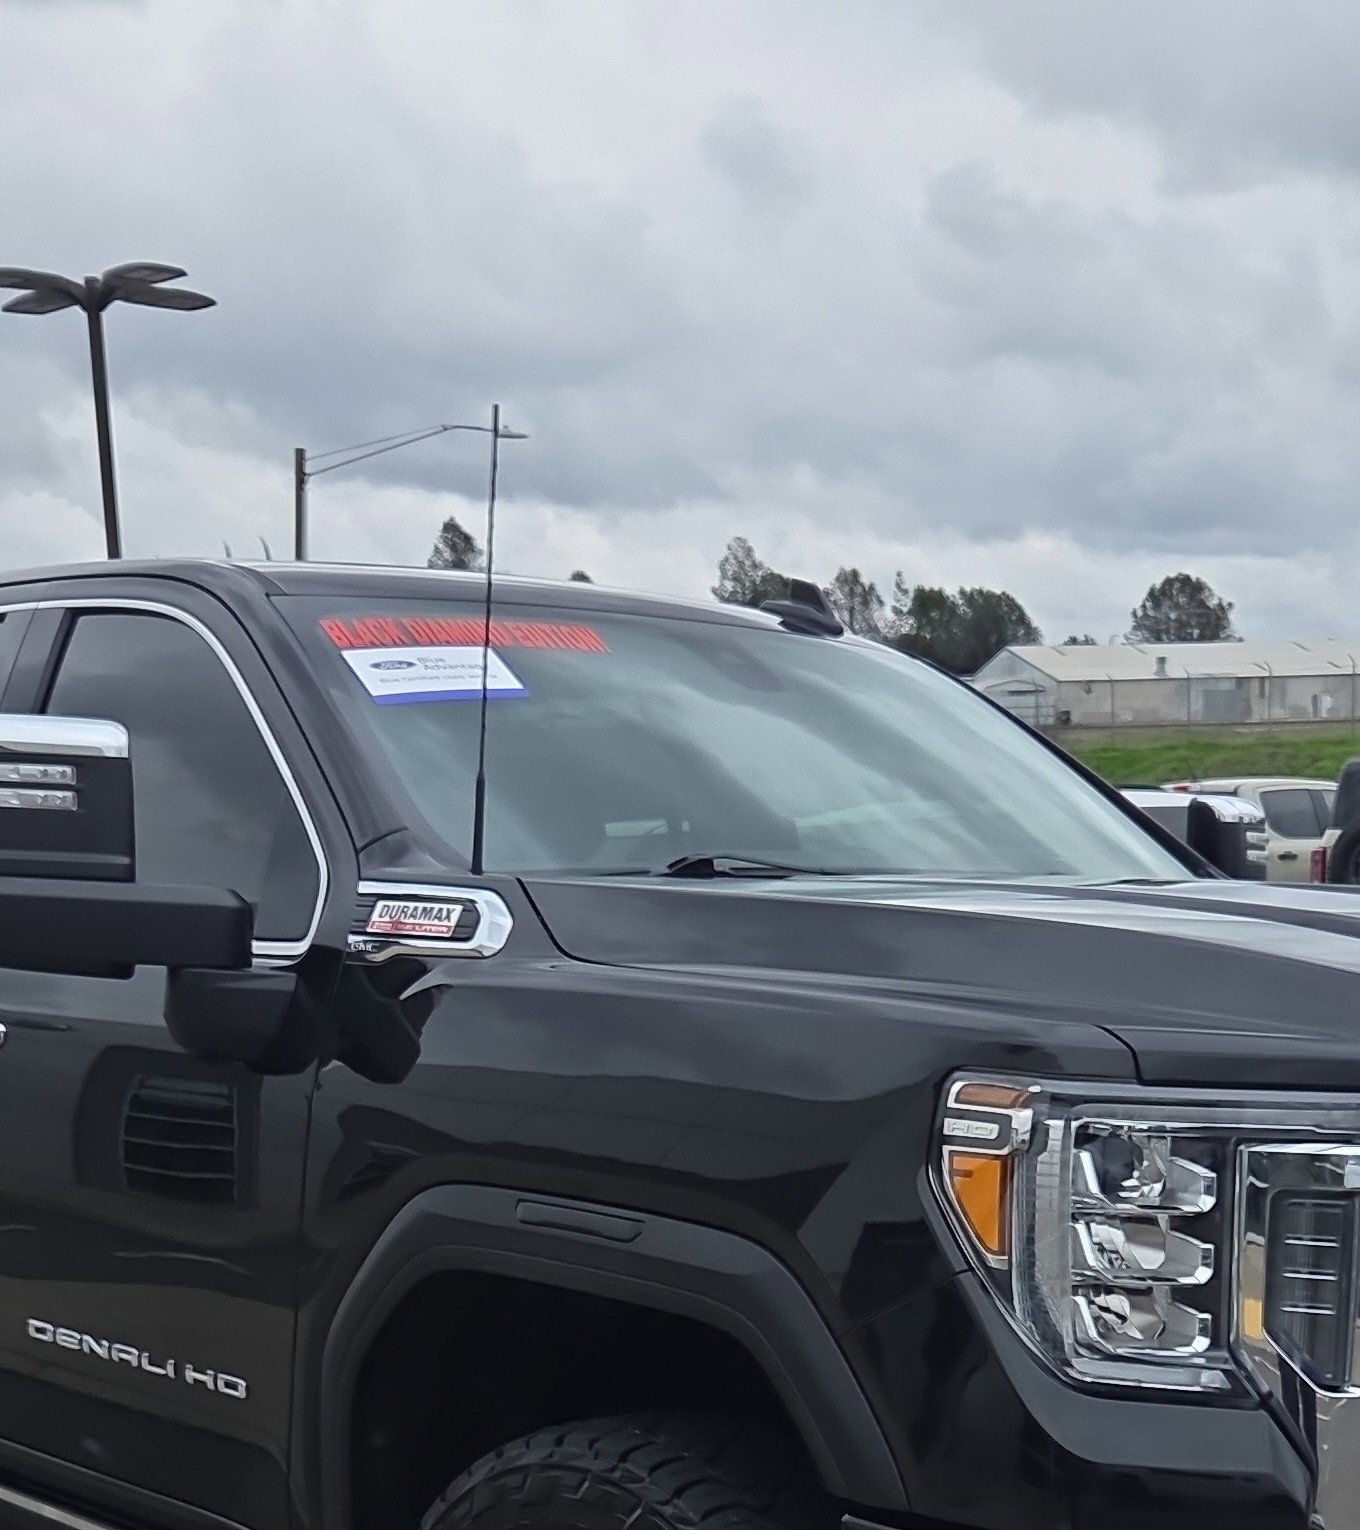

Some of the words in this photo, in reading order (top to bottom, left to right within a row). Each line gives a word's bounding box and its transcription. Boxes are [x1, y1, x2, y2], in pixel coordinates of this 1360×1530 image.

[378, 904, 457, 923] DURAMAX
[27, 1318, 176, 1379] DENALI
[185, 1363, 248, 1400] HD
